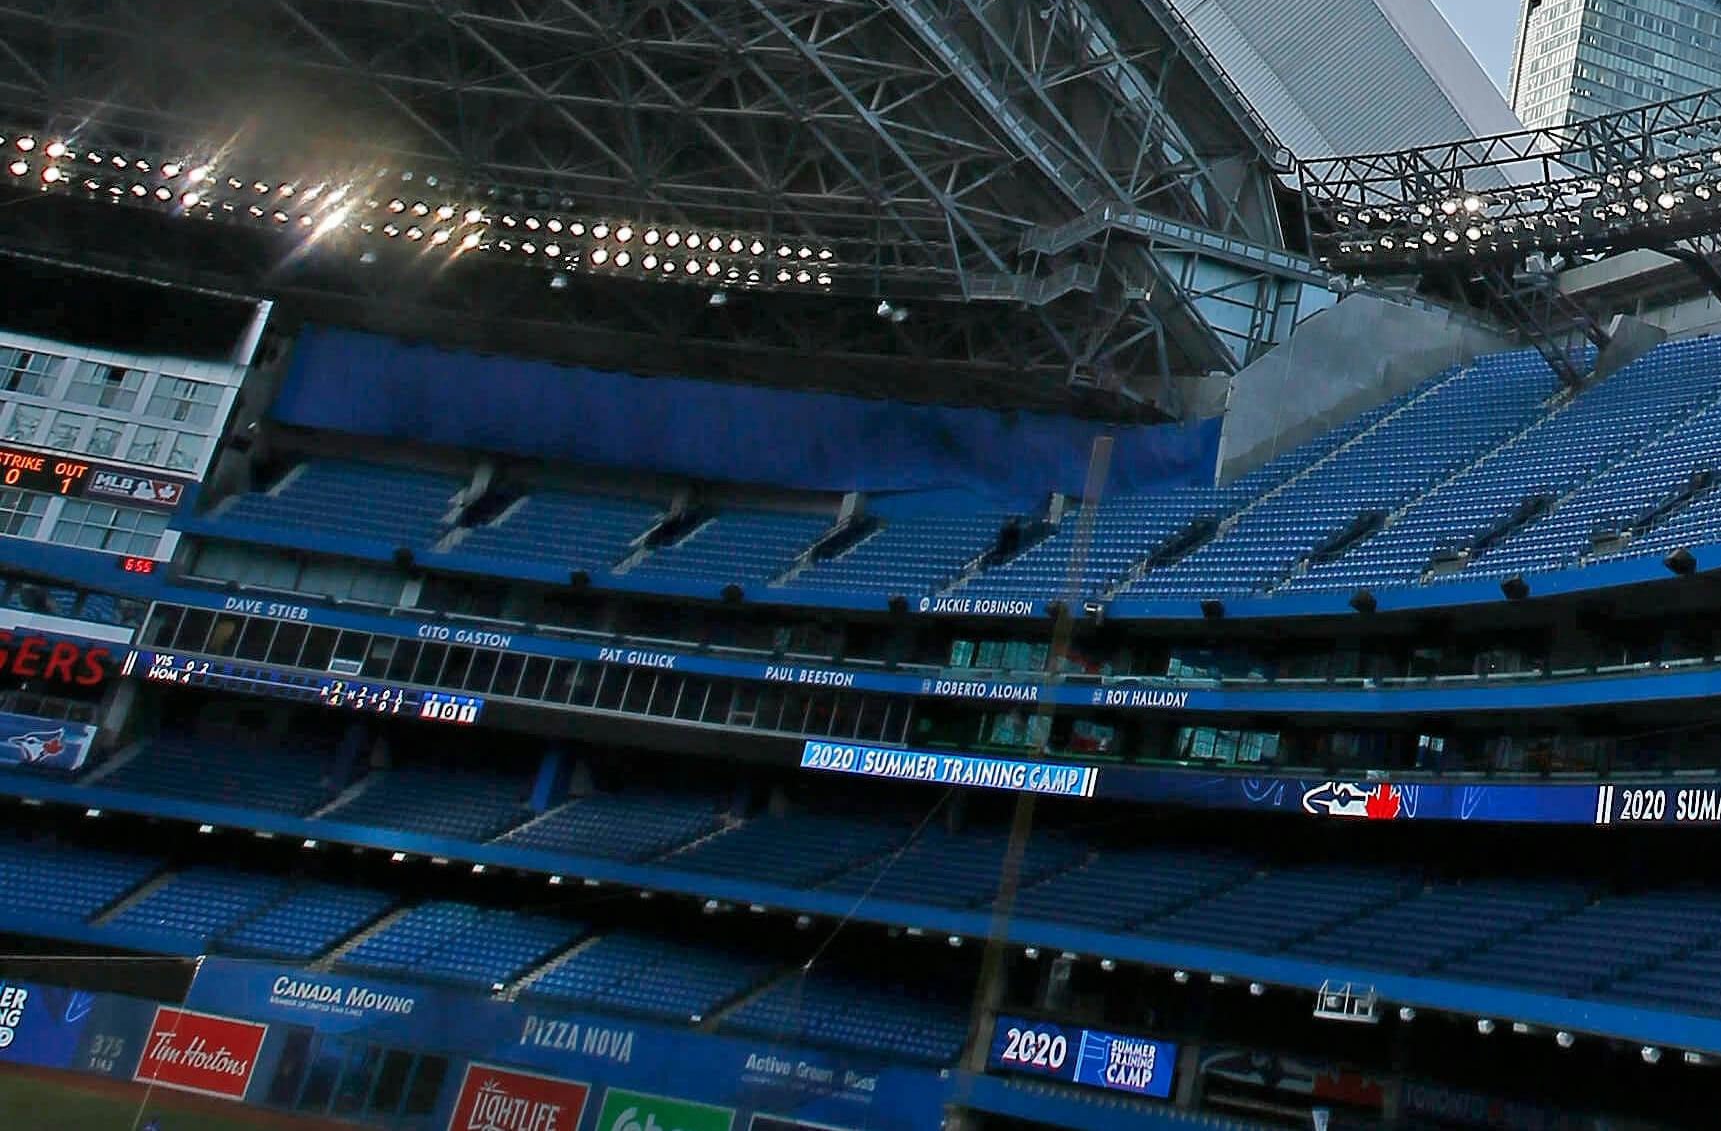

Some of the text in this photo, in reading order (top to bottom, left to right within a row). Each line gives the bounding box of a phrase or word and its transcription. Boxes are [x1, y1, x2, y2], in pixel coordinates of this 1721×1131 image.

[55, 462, 88, 478] OUT
[5, 468, 73, 494] 0 1
[96, 474, 134, 489] MLB
[225, 597, 308, 620] DAVE STIEB
[933, 598, 1032, 615] JACKIE ROBINSON
[418, 625, 511, 647] CITO GASTON
[155, 653, 175, 667] VIS
[599, 648, 676, 668] PAT GILLICK
[148, 666, 179, 682] HOM
[765, 666, 854, 686] PAUL BEESTON
[358, 686, 368, 697] 2
[935, 681, 1037, 701] ROBERTO ALOMAR
[1105, 690, 1188, 708] ROY HALLADAY
[356, 698, 364, 709] 5
[809, 745, 1079, 793] 2020 SUMMER TRAINING CAMP
[1620, 789, 1666, 820] 2020
[272, 975, 415, 1014] CANADA MOVING
[520, 1015, 634, 1063] PIZZA NOVA
[1002, 1027, 1067, 1069] 2020
[1111, 1039, 1156, 1058] SUMMER
[150, 1031, 248, 1077] Tim Hortons
[745, 1052, 791, 1076] Active
[1110, 1052, 1154, 1069] TRAINING
[1107, 1064, 1152, 1088] CAMP
[467, 1090, 561, 1131] LIGHTLIFE
